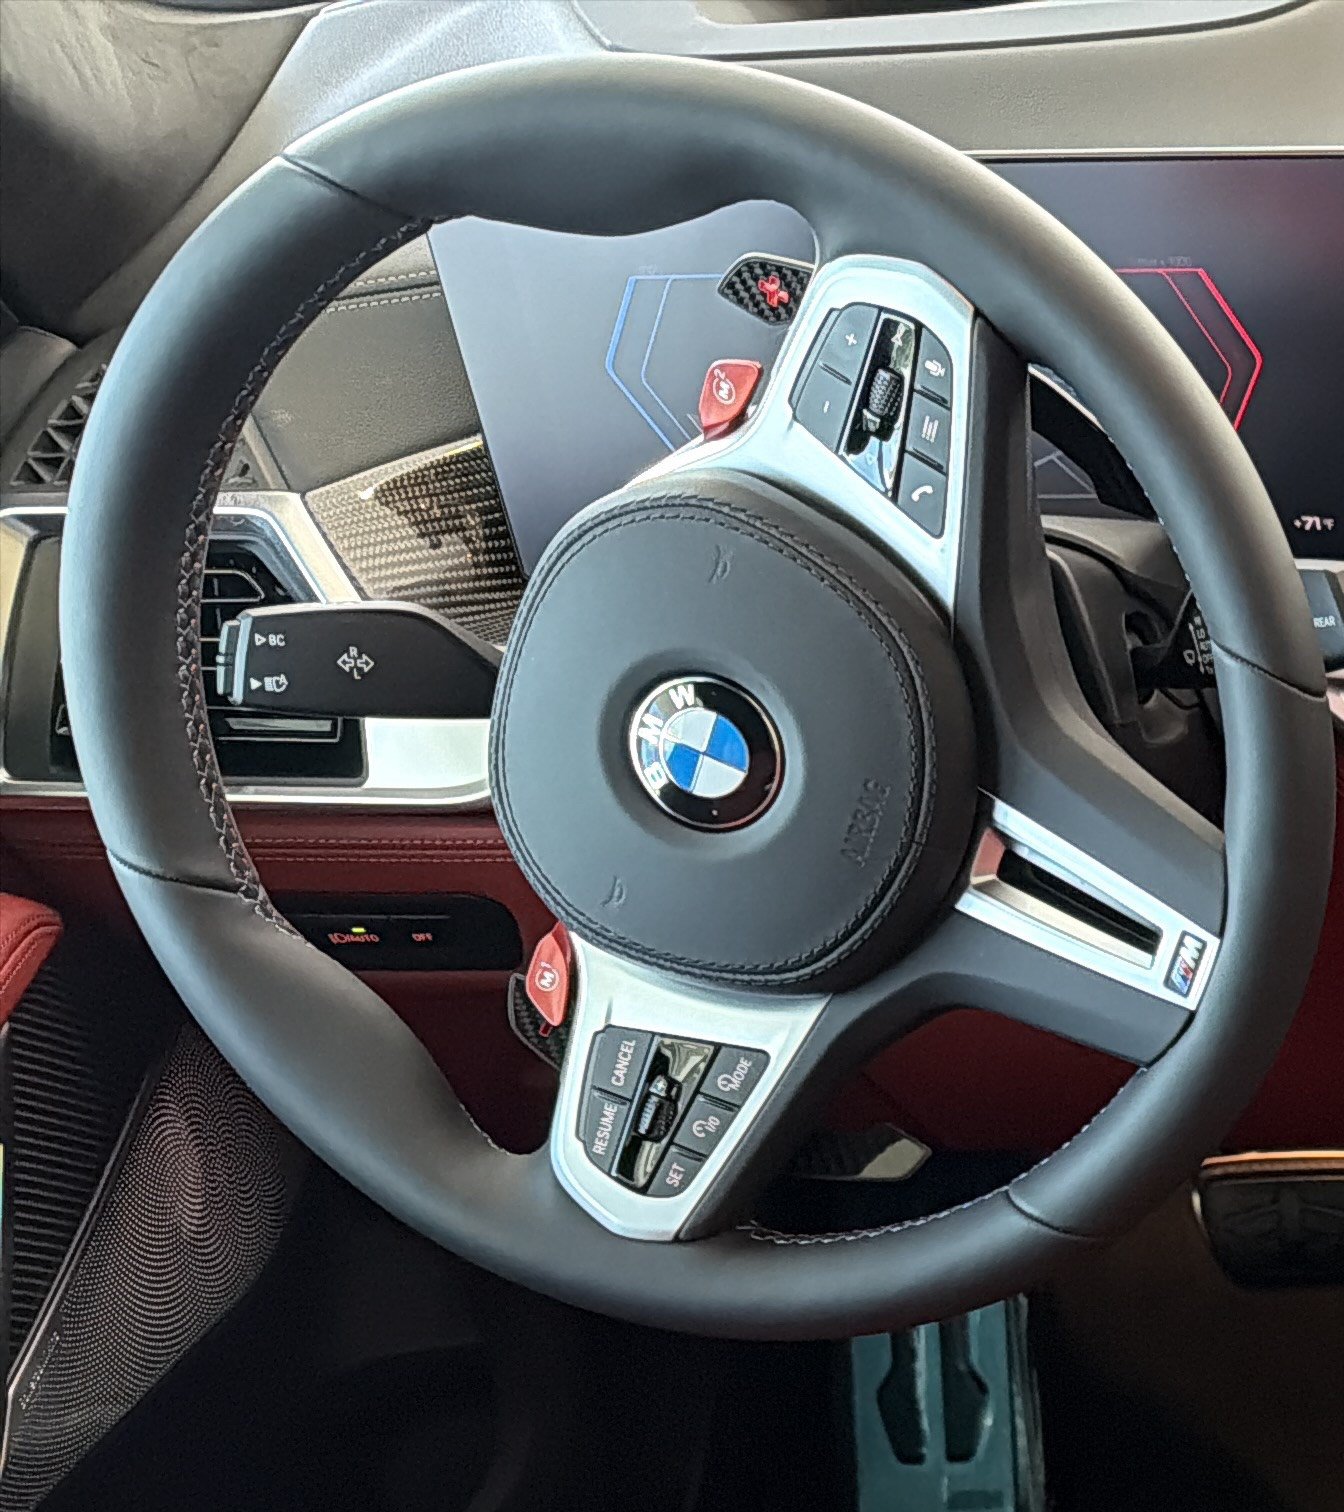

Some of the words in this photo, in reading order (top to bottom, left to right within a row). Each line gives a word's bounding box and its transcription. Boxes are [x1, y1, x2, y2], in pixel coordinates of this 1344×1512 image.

[1313, 615, 1336, 628] REAR
[637, 682, 697, 794] BMW
[610, 1039, 637, 1088] CANCEL
[728, 1056, 753, 1092] MODE
[591, 1101, 618, 1156] RESUME
[665, 1161, 686, 1188] SET
